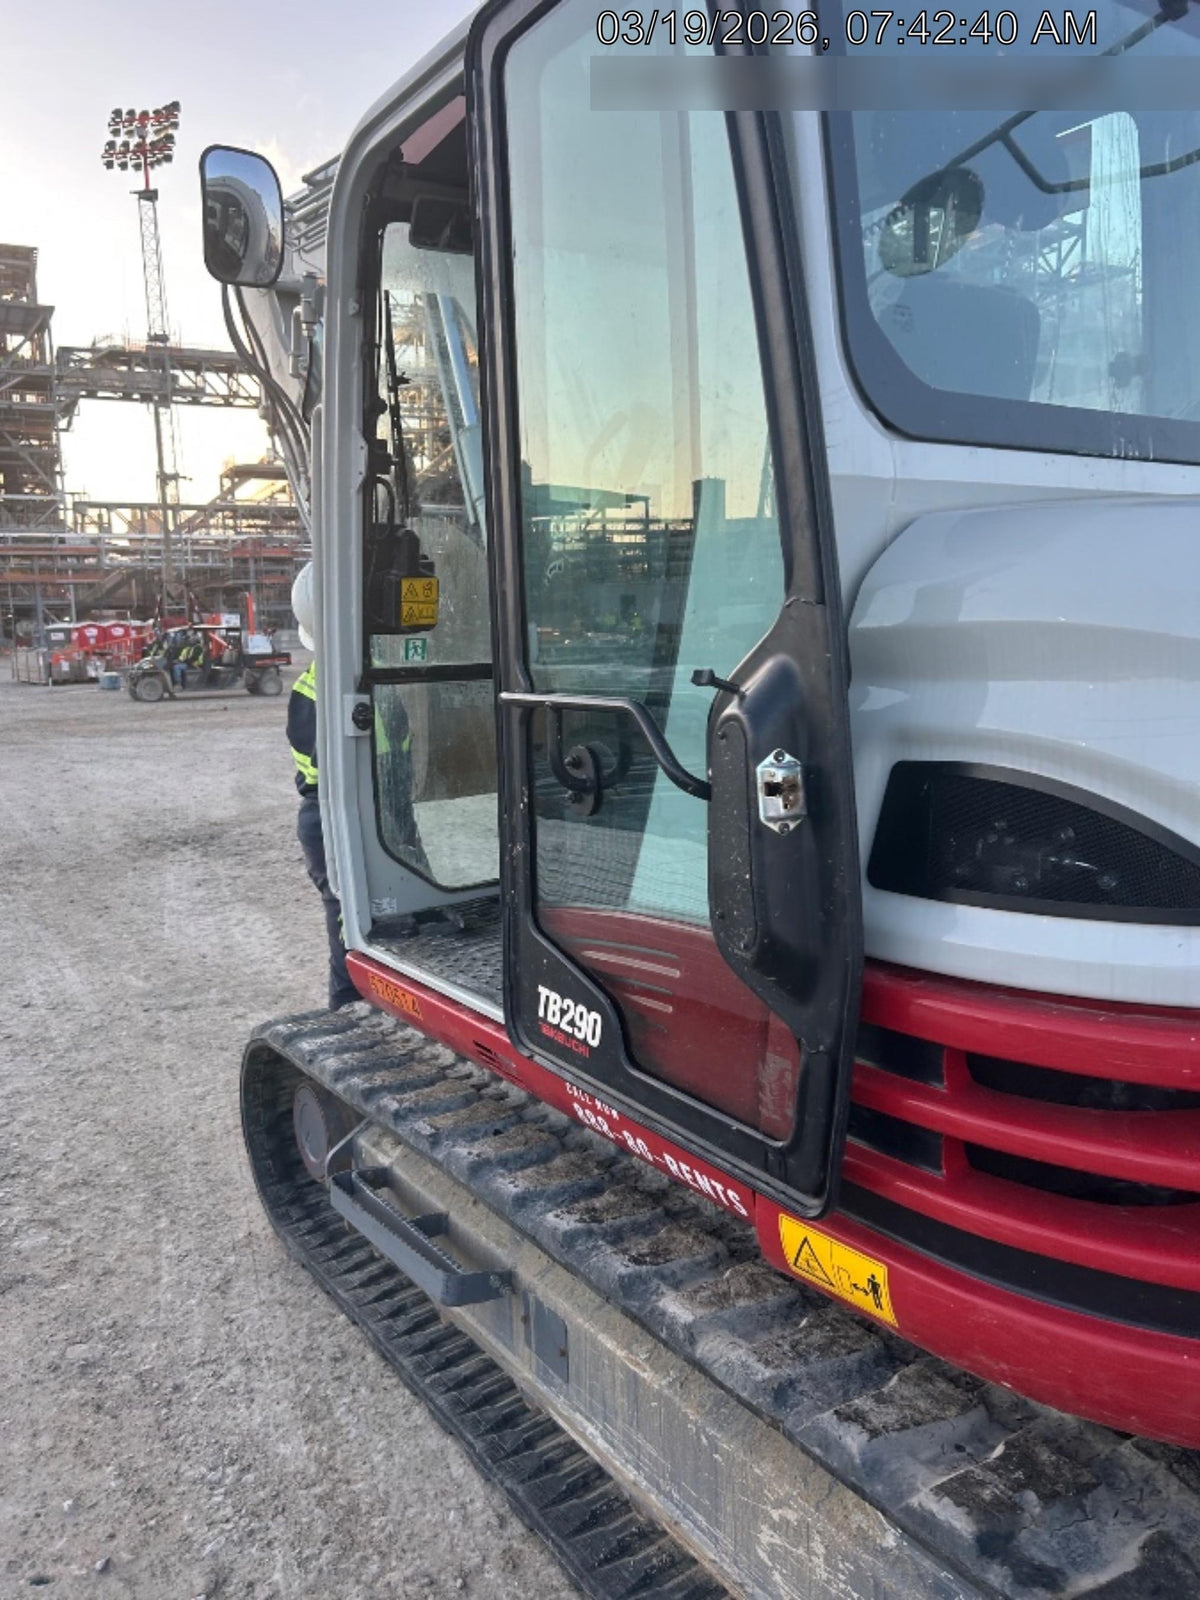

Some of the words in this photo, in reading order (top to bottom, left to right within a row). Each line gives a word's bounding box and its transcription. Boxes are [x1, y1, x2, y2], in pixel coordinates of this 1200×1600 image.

[537, 984, 602, 1048] TB290
[565, 1082, 592, 1105] CALL
[572, 1102, 749, 1217] 888-80-RENTS
